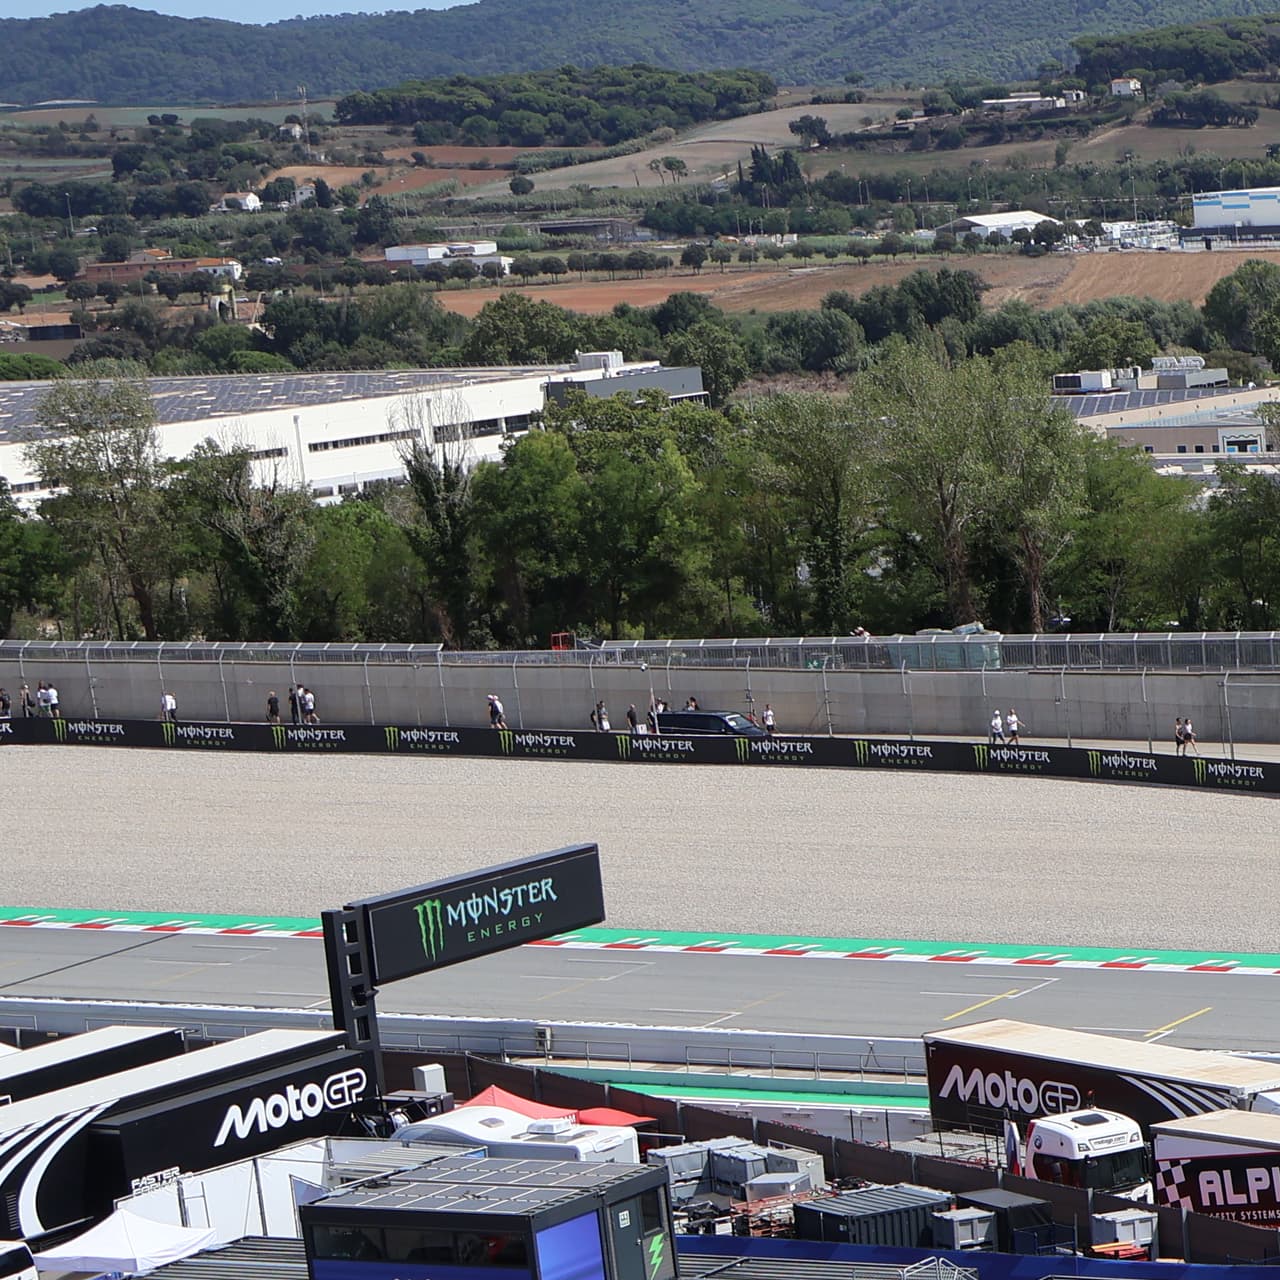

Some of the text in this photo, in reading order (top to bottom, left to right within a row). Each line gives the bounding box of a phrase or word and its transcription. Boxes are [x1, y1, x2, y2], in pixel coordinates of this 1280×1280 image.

[68, 721, 124, 736] MONSTER
[177, 725, 234, 740] MONSTER
[287, 728, 345, 742] MONSTER
[401, 729, 459, 744] MONSTER
[515, 733, 575, 747] MONSTER
[632, 738, 694, 753] MONSTER
[752, 740, 813, 753] MONSTER
[1208, 762, 1264, 778] MONSTER
[447, 878, 558, 927] MONSTER
[467, 912, 544, 943] ENERGY
[939, 1064, 1081, 1115] MotoGP
[213, 1068, 367, 1147] MotoGP
[131, 1166, 180, 1189] FASTER
